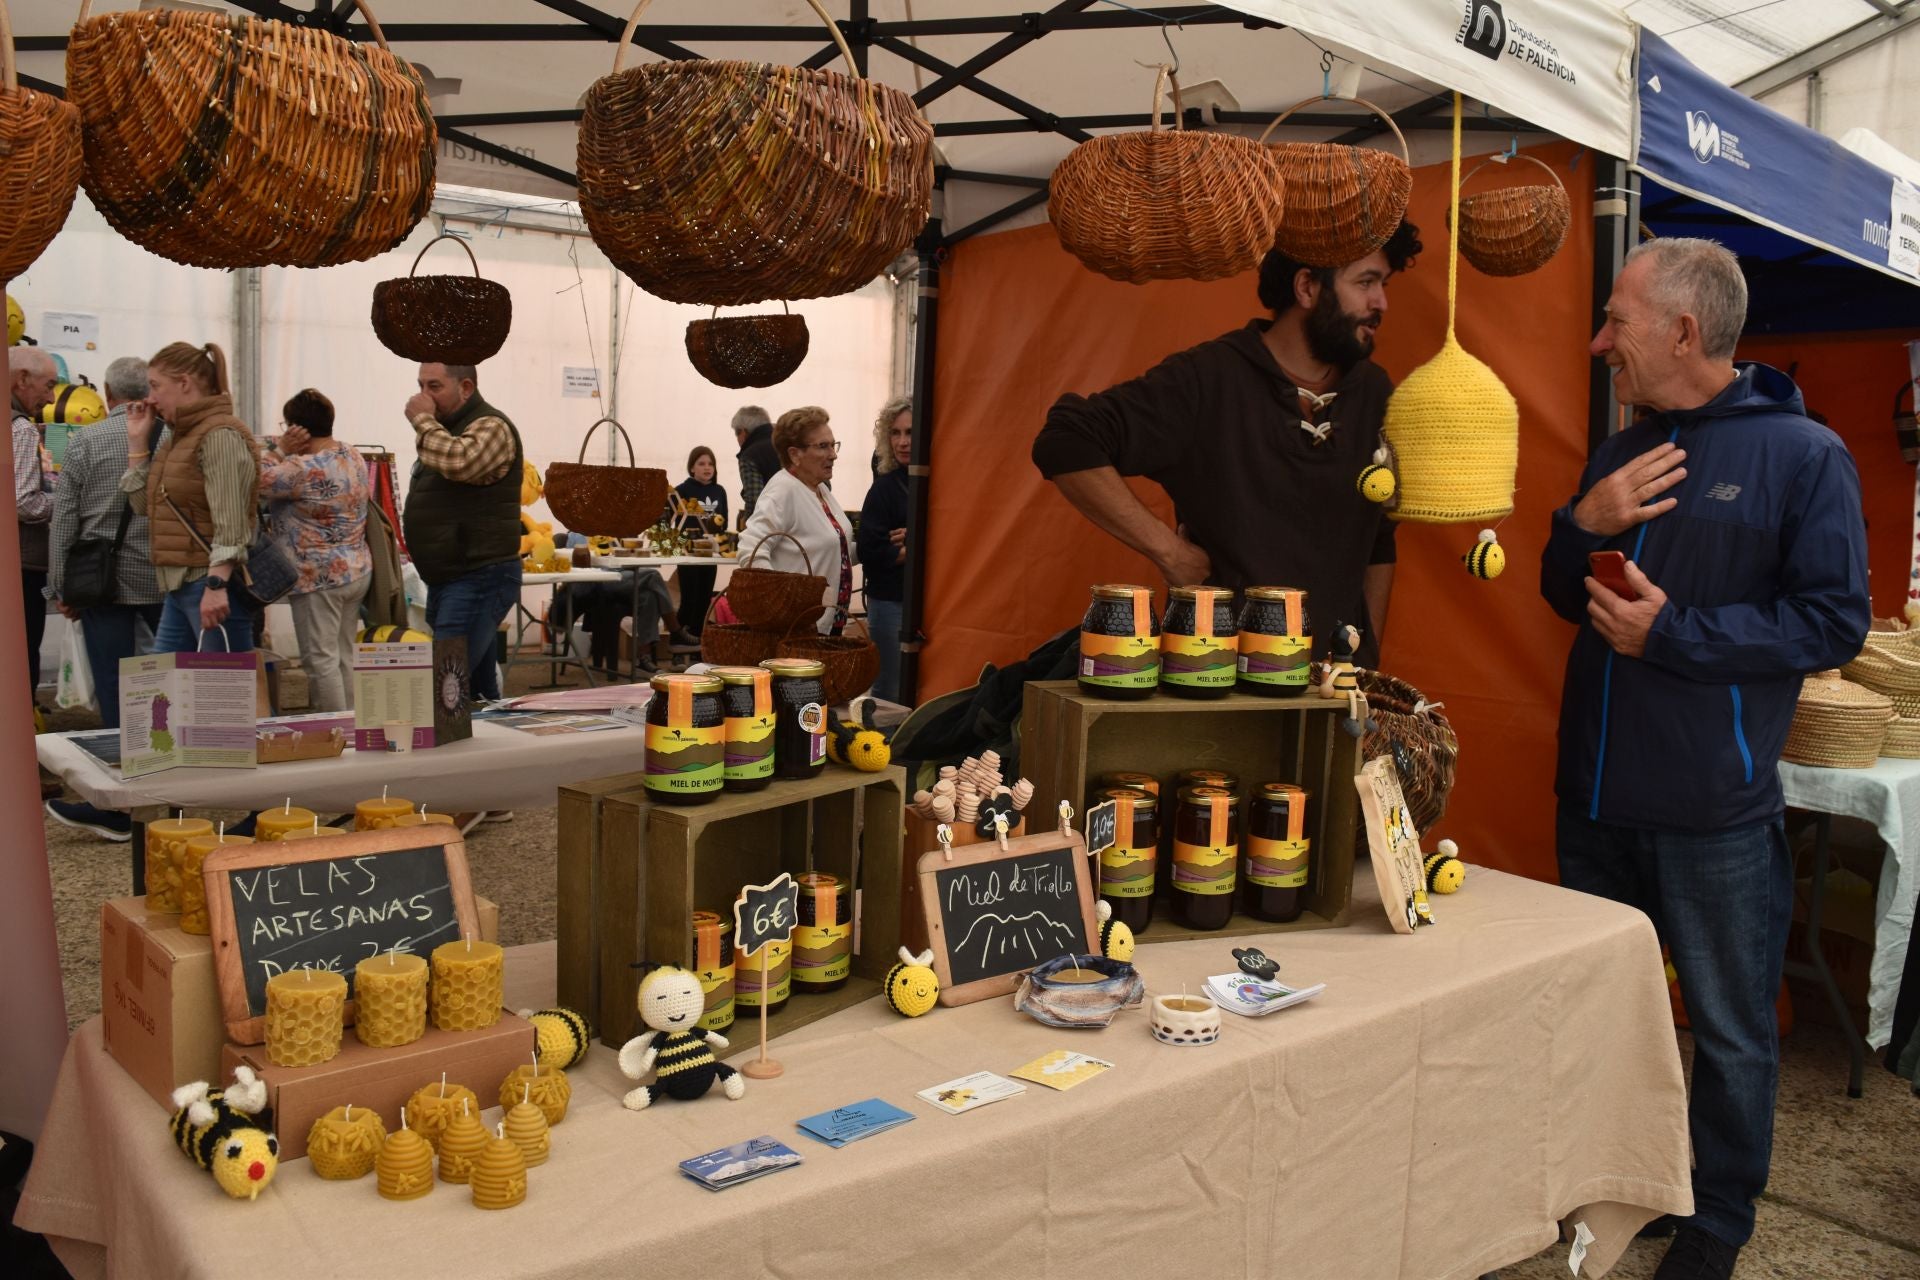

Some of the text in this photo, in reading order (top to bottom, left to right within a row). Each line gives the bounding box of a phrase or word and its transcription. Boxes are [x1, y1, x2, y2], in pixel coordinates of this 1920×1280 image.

[1508, 19, 1559, 59] Diputación
[1508, 40, 1576, 84] DE PALENCIA
[1863, 218, 1890, 250] mont
[63, 325, 80, 333] PIA
[670, 779, 689, 788] MIEL
[691, 779, 701, 788] DE
[1093, 812, 1114, 842] 10€
[235, 856, 377, 905] VELAS
[949, 871, 1005, 911] Miel
[1009, 863, 1027, 893] de
[253, 894, 433, 945] ARTESANAS
[753, 897, 788, 935] 6€
[824, 969, 839, 977] MIEL
[708, 1015, 725, 1026] MIEL
